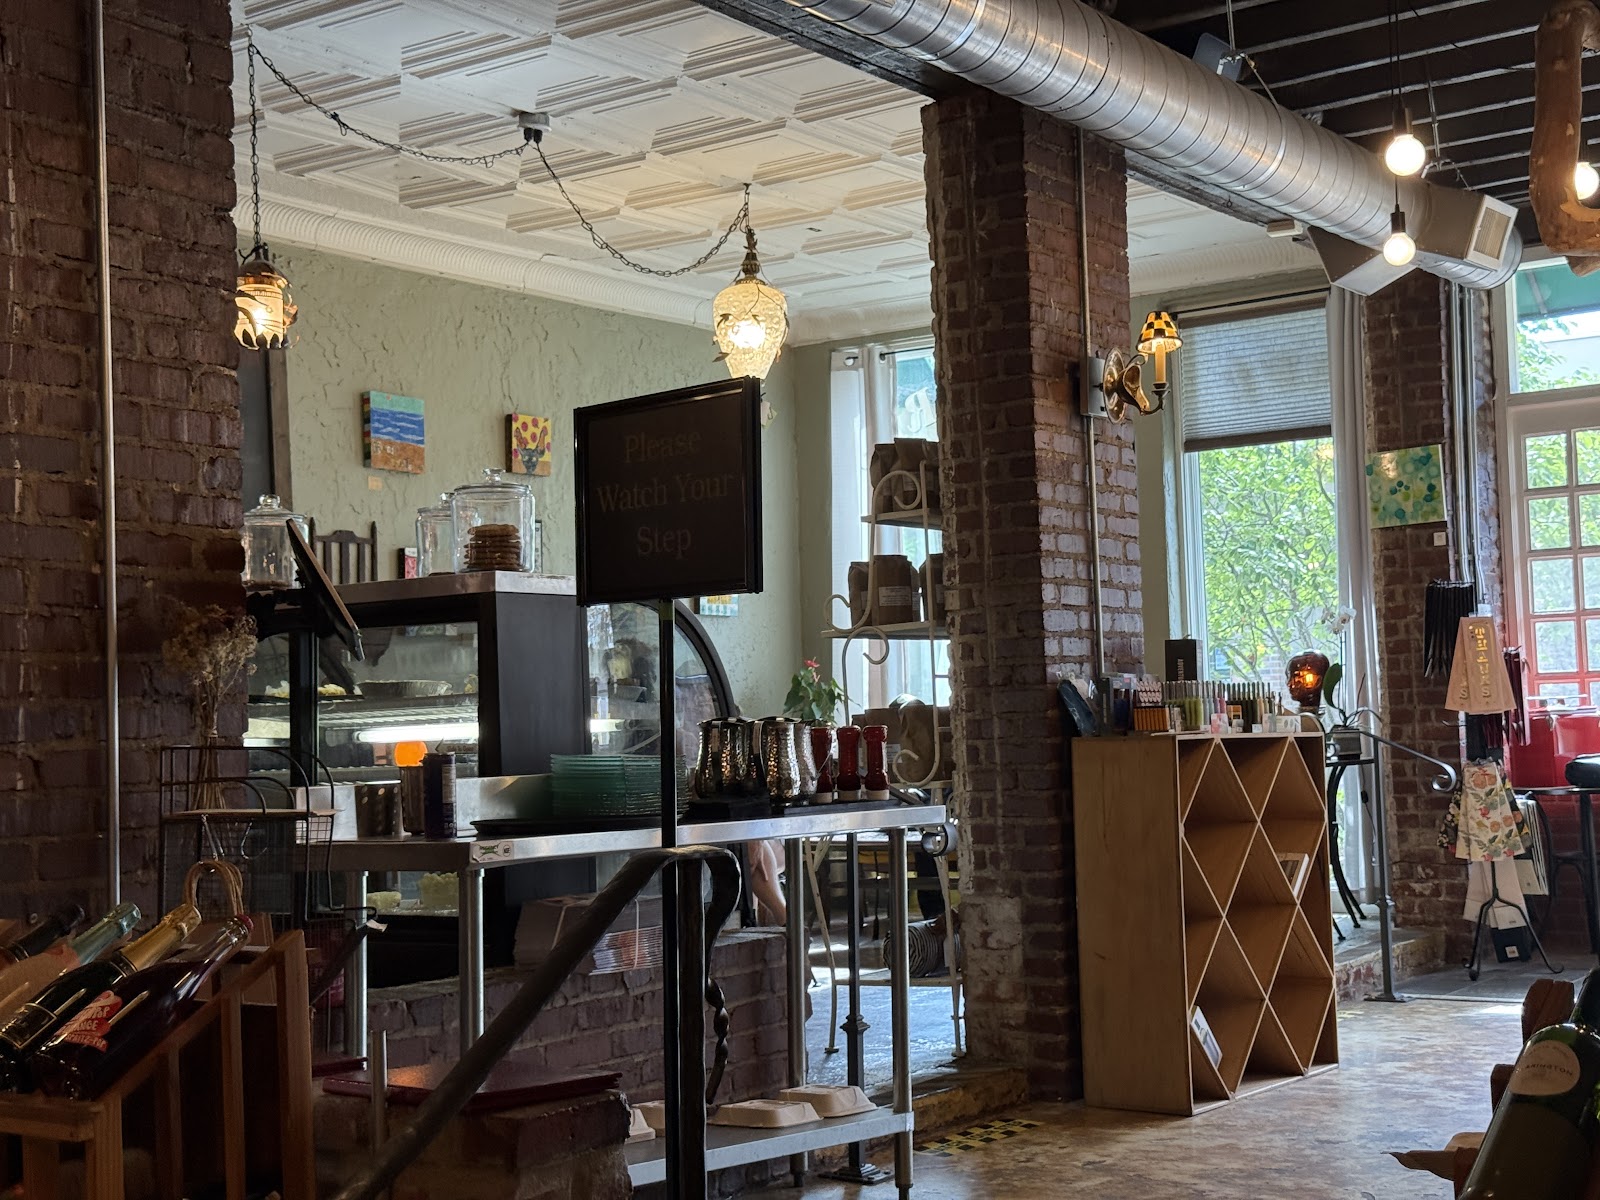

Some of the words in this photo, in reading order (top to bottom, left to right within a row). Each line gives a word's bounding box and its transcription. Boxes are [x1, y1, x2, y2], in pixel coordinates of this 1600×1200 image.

[624, 431, 702, 463] Please
[596, 478, 667, 513] Watch
[674, 473, 735, 503] Your
[637, 526, 692, 559] Step
